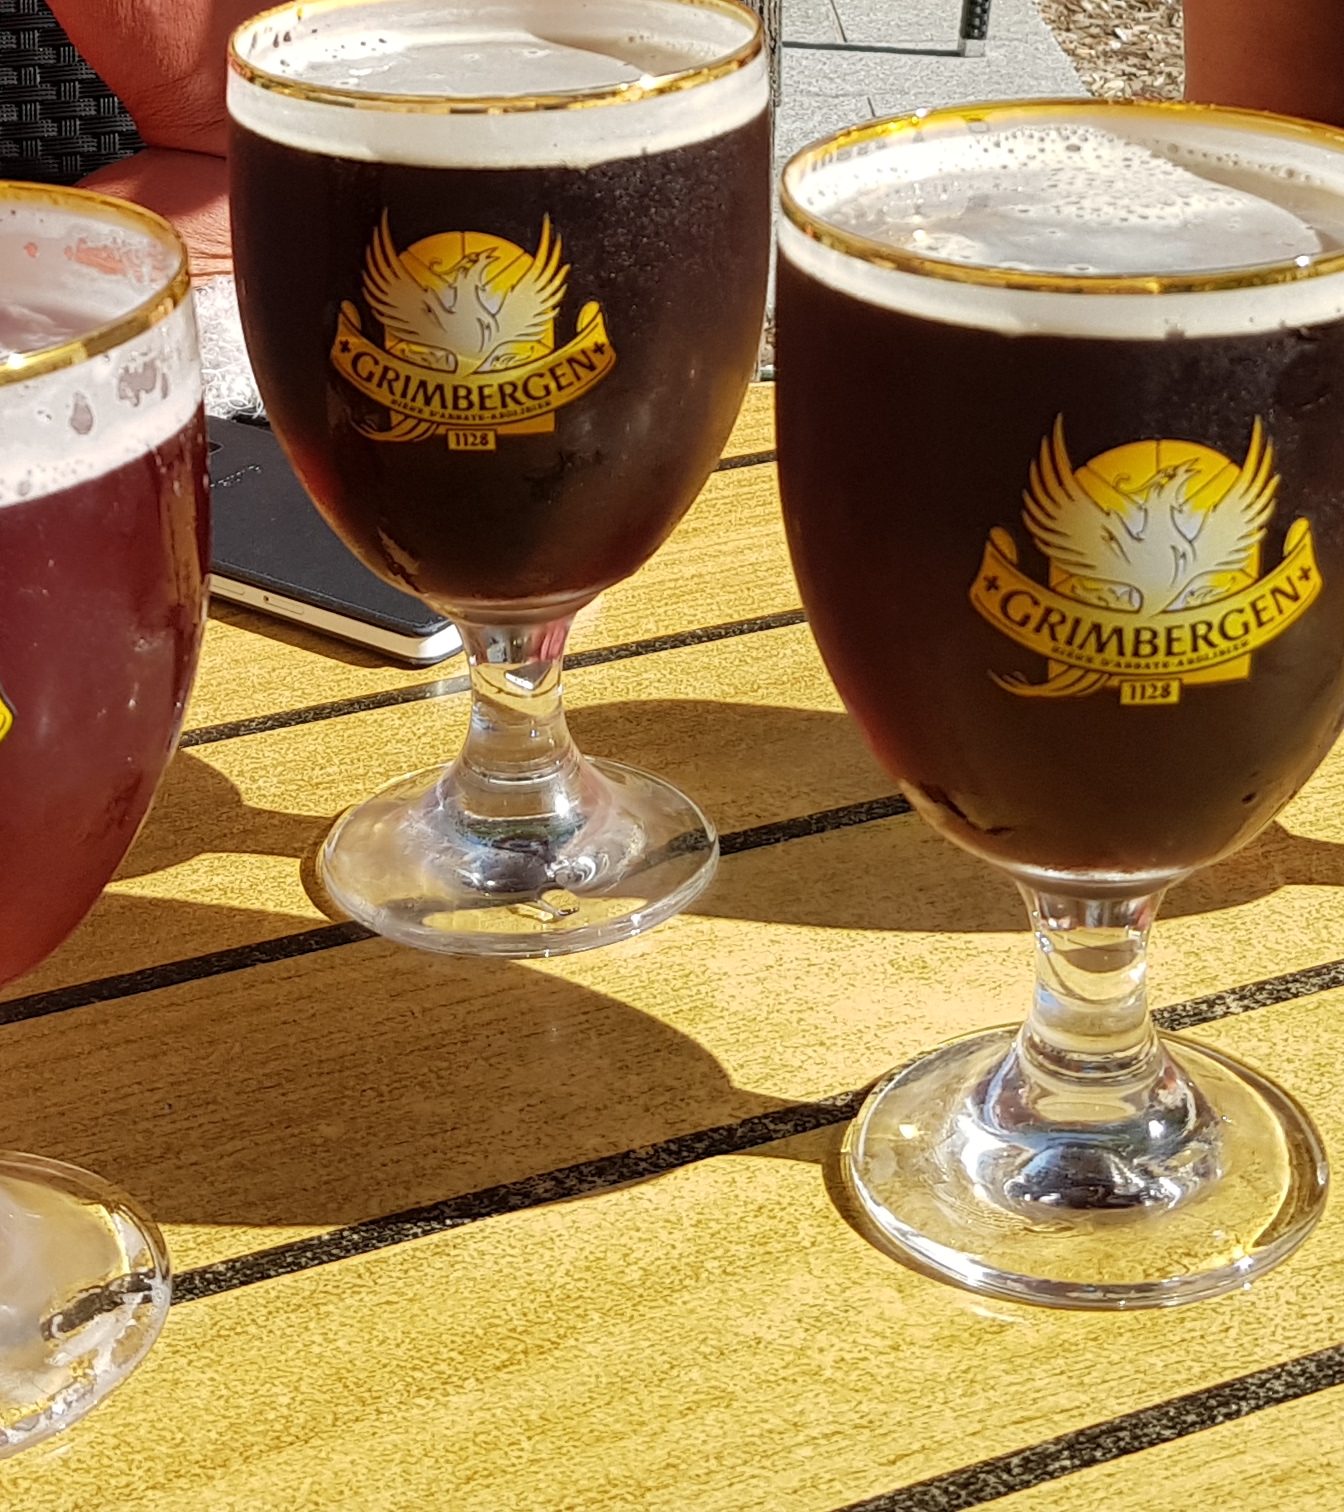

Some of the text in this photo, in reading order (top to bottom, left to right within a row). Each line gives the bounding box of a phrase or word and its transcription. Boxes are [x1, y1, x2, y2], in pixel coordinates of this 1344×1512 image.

[351, 349, 598, 411] GRIMBERGEN
[454, 431, 490, 447] 1128
[1000, 574, 1302, 659] GRIMBERGEN
[1129, 682, 1172, 701] 1128
